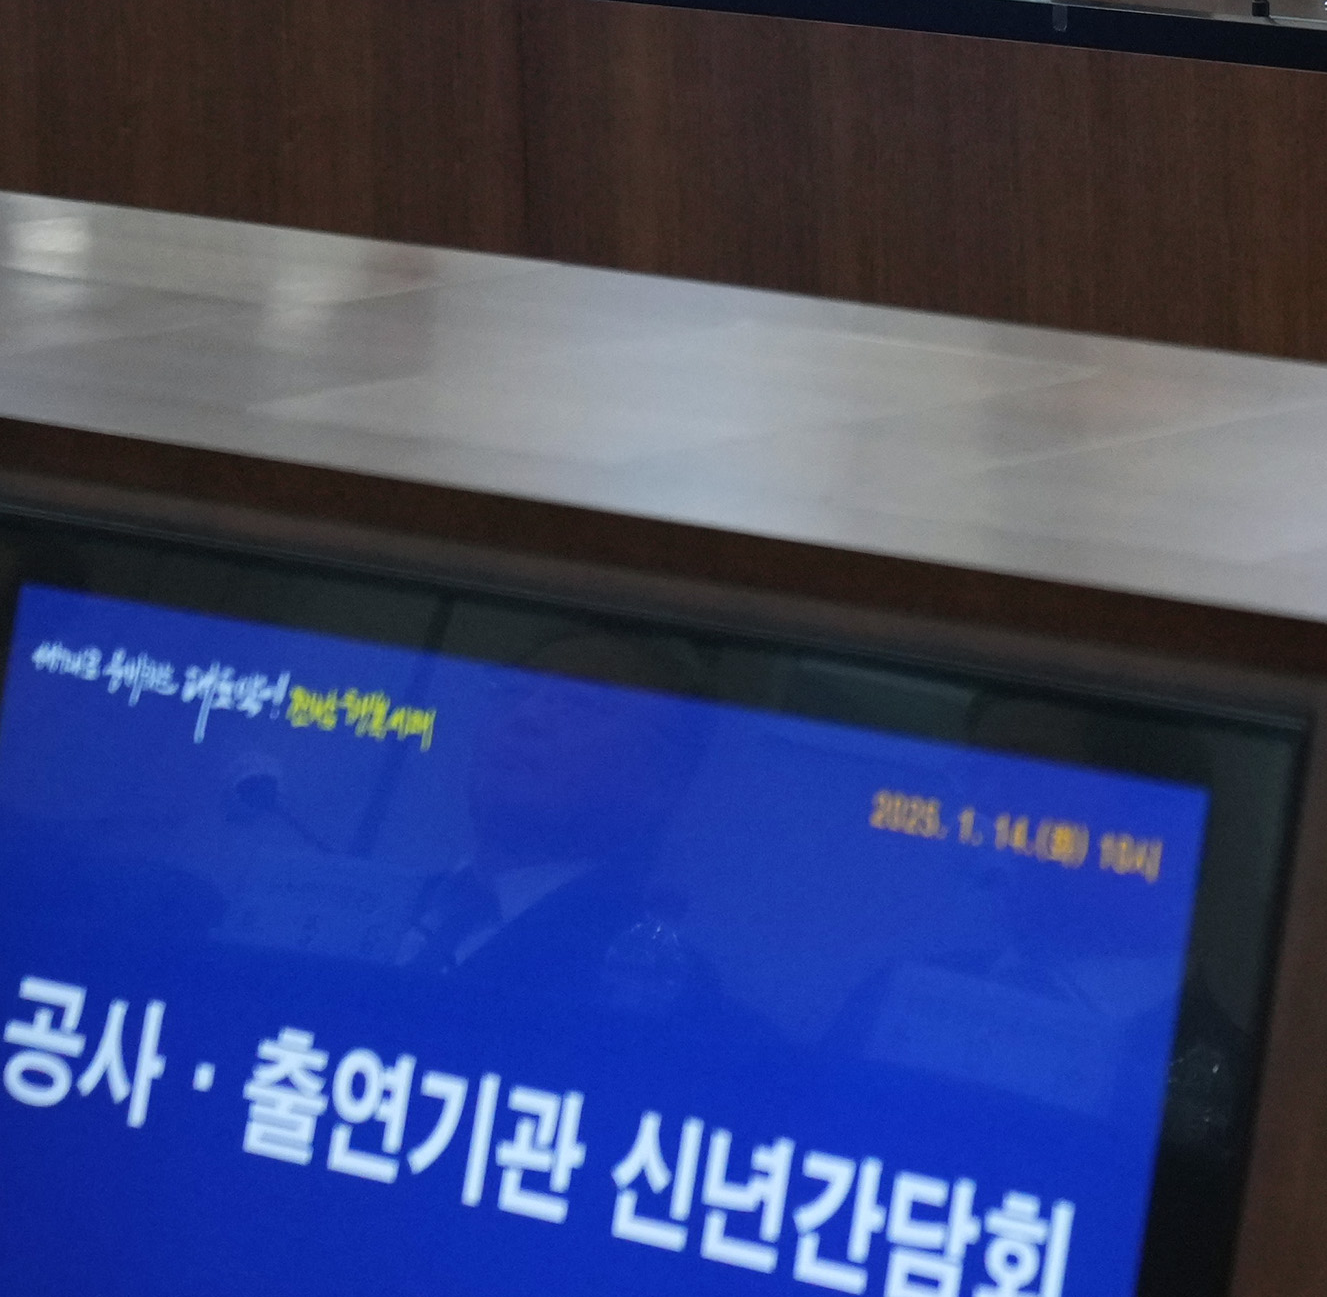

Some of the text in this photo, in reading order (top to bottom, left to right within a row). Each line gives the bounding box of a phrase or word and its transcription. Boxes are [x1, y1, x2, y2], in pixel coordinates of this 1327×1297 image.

[3, 977, 165, 1129] 공사
[242, 1027, 587, 1224] 출연기관
[611, 1111, 1075, 1297] 신년간담회
